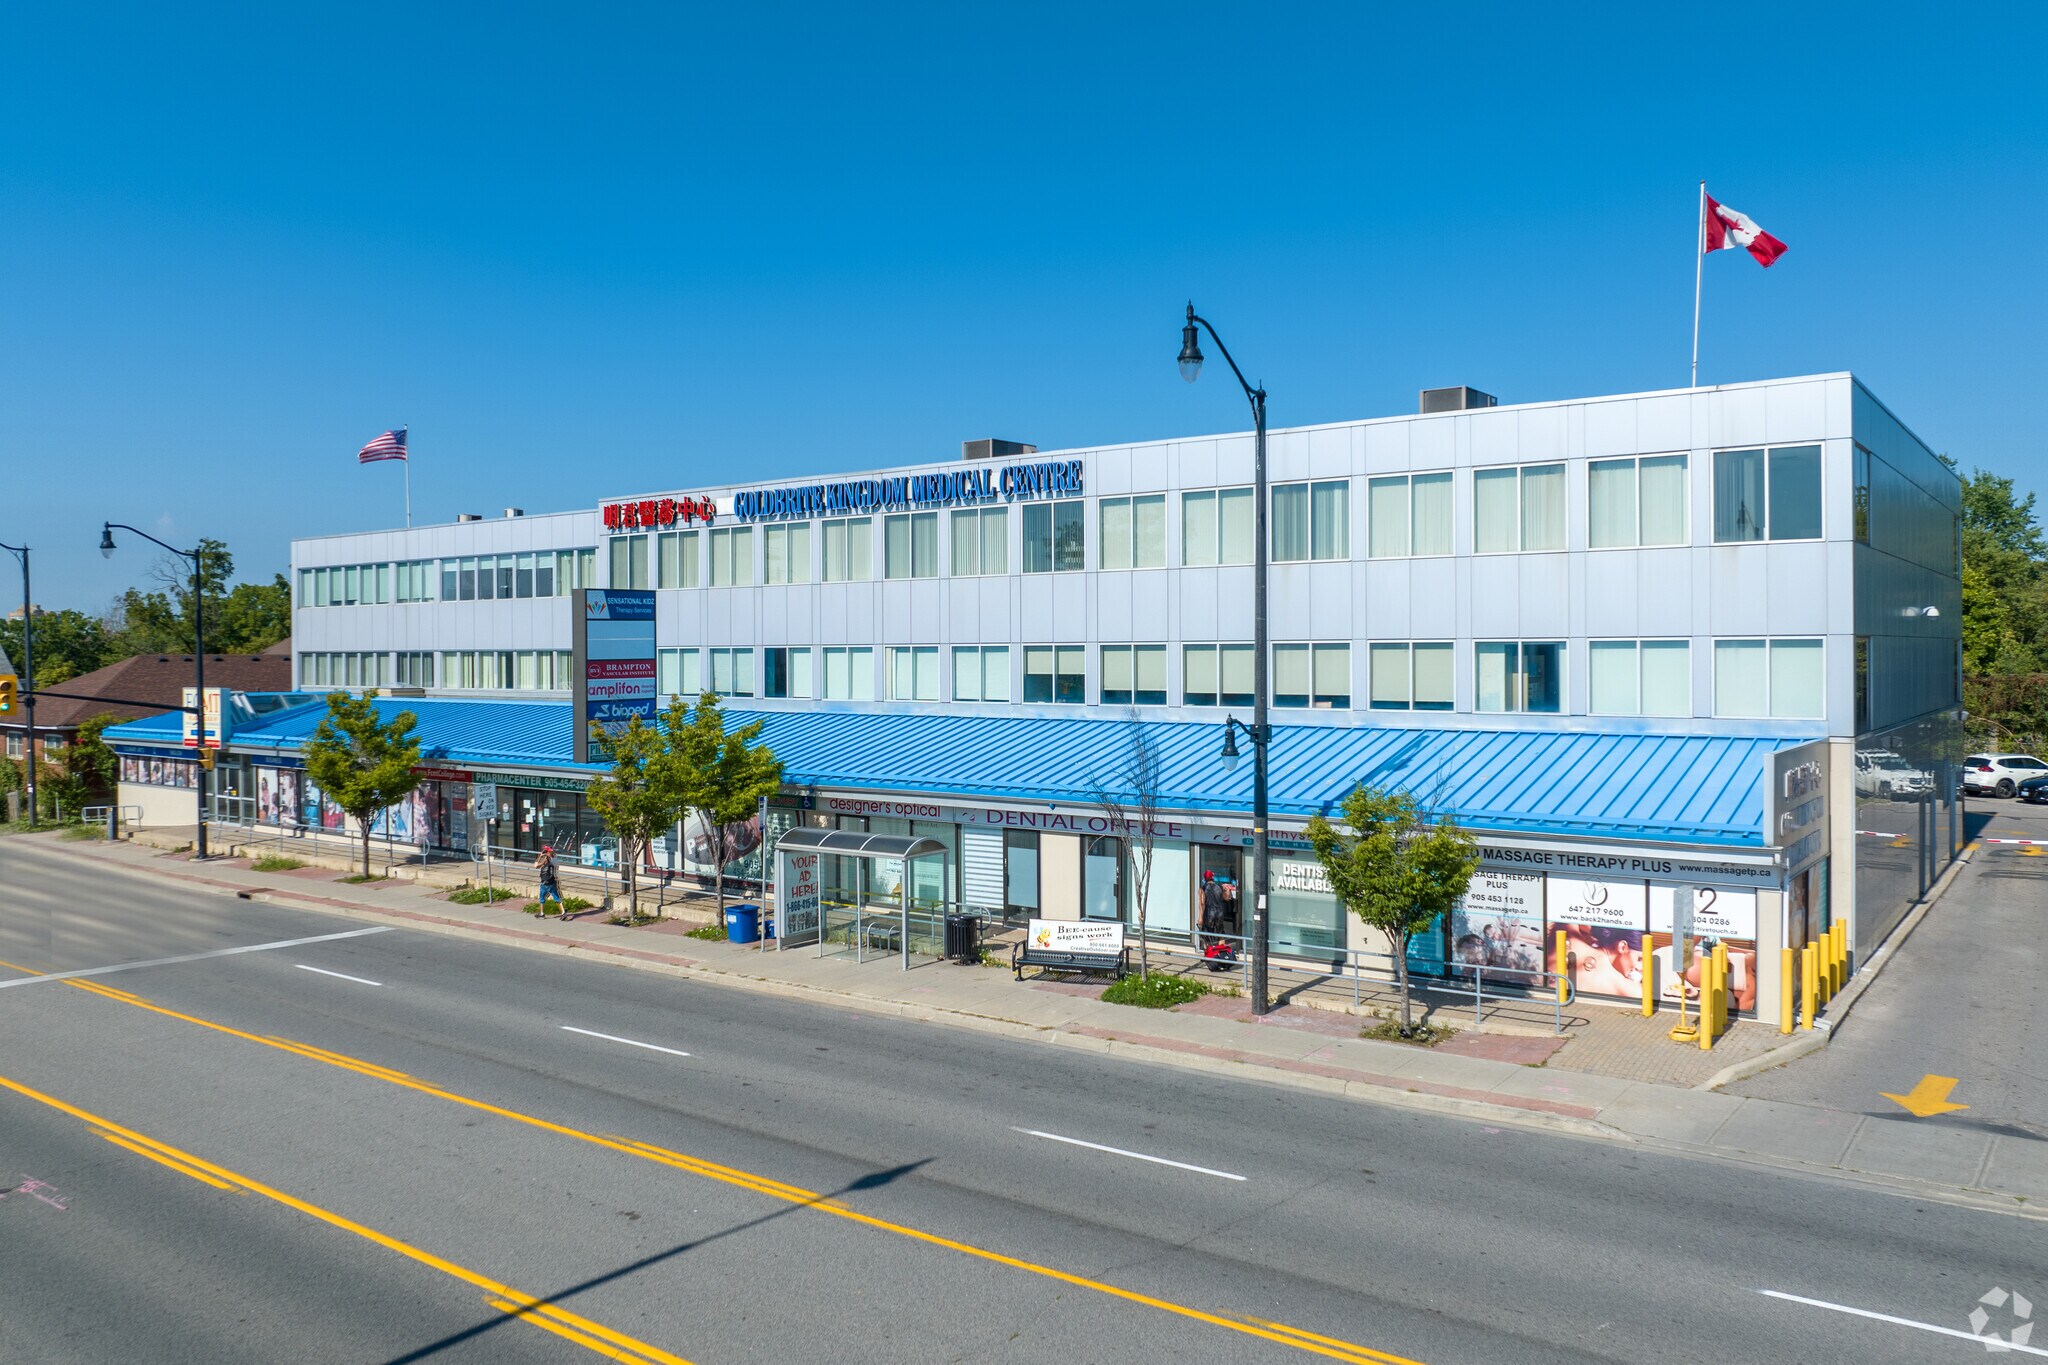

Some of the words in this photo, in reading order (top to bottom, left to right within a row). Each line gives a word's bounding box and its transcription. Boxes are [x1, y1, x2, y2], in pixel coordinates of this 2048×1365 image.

[734, 485, 823, 518] GOLDBRITE
[826, 476, 909, 511] KINGDOM
[911, 468, 995, 503] MEDICAL
[999, 460, 1083, 497] CENTRE
[607, 597, 642, 605] SENSATIONAL
[616, 606, 634, 614] Therapy
[588, 682, 640, 698] amplifon
[476, 772, 541, 786] PHARMACENTER
[829, 798, 891, 814] designer's
[895, 802, 941, 817] optical
[986, 809, 1082, 831] DENTAL
[1088, 817, 1182, 838] OFFICE
[791, 855, 818, 869] YOUR
[1483, 849, 1553, 865] MASSAGE
[1557, 854, 1627, 870] THERAPY
[1632, 859, 1672, 873] PLUS
[1679, 864, 1771, 877] www.massagetp.ca
[799, 870, 812, 883] AD
[1501, 872, 1541, 883] THERAPY
[1486, 880, 1508, 889] PLUS
[1471, 893, 1486, 901] 905
[1487, 894, 1502, 903] 453
[1504, 896, 1524, 905] 1128
[1699, 887, 1718, 915] 2
[1467, 904, 1529, 914] www.massagetp.ca
[1568, 905, 1584, 913] 647
[1586, 906, 1601, 914] 217
[1603, 908, 1624, 917] 9600
[1560, 914, 1633, 926] www.back2hands.ca
[1709, 917, 1730, 926] 0286
[1070, 945, 1119, 953] CreativeOutdoor.com
